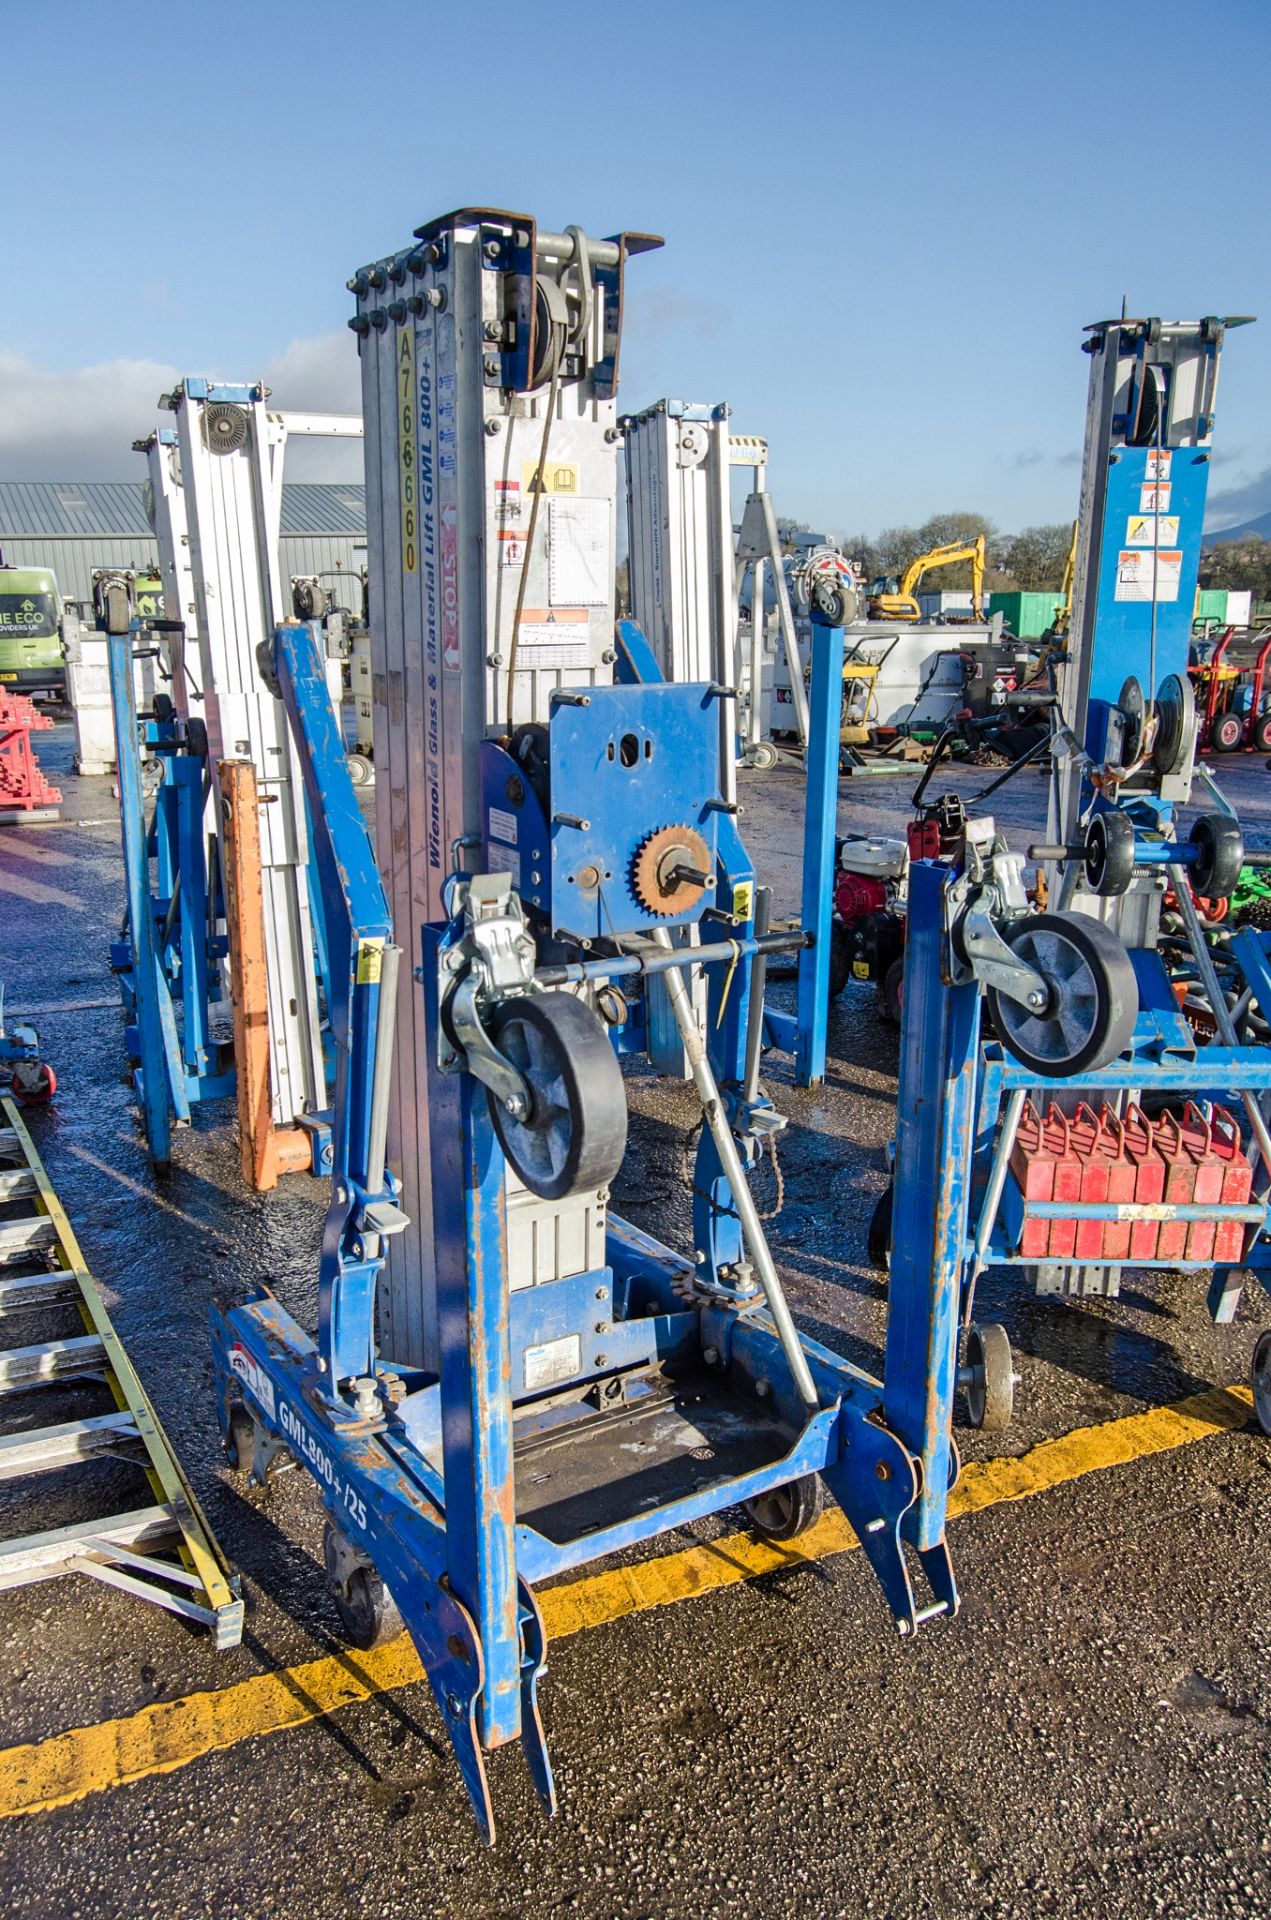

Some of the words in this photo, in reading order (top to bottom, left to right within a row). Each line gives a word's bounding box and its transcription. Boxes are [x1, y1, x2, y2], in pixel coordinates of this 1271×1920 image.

[420, 356, 432, 429] 800+
[421, 439, 433, 505] GML
[424, 513, 434, 555] Lift
[15, 612, 44, 624] ECO
[425, 561, 436, 664] Material
[444, 553, 457, 626] STOP
[428, 673, 437, 690] &
[429, 697, 438, 753] Glass
[426, 757, 440, 869] Wienold
